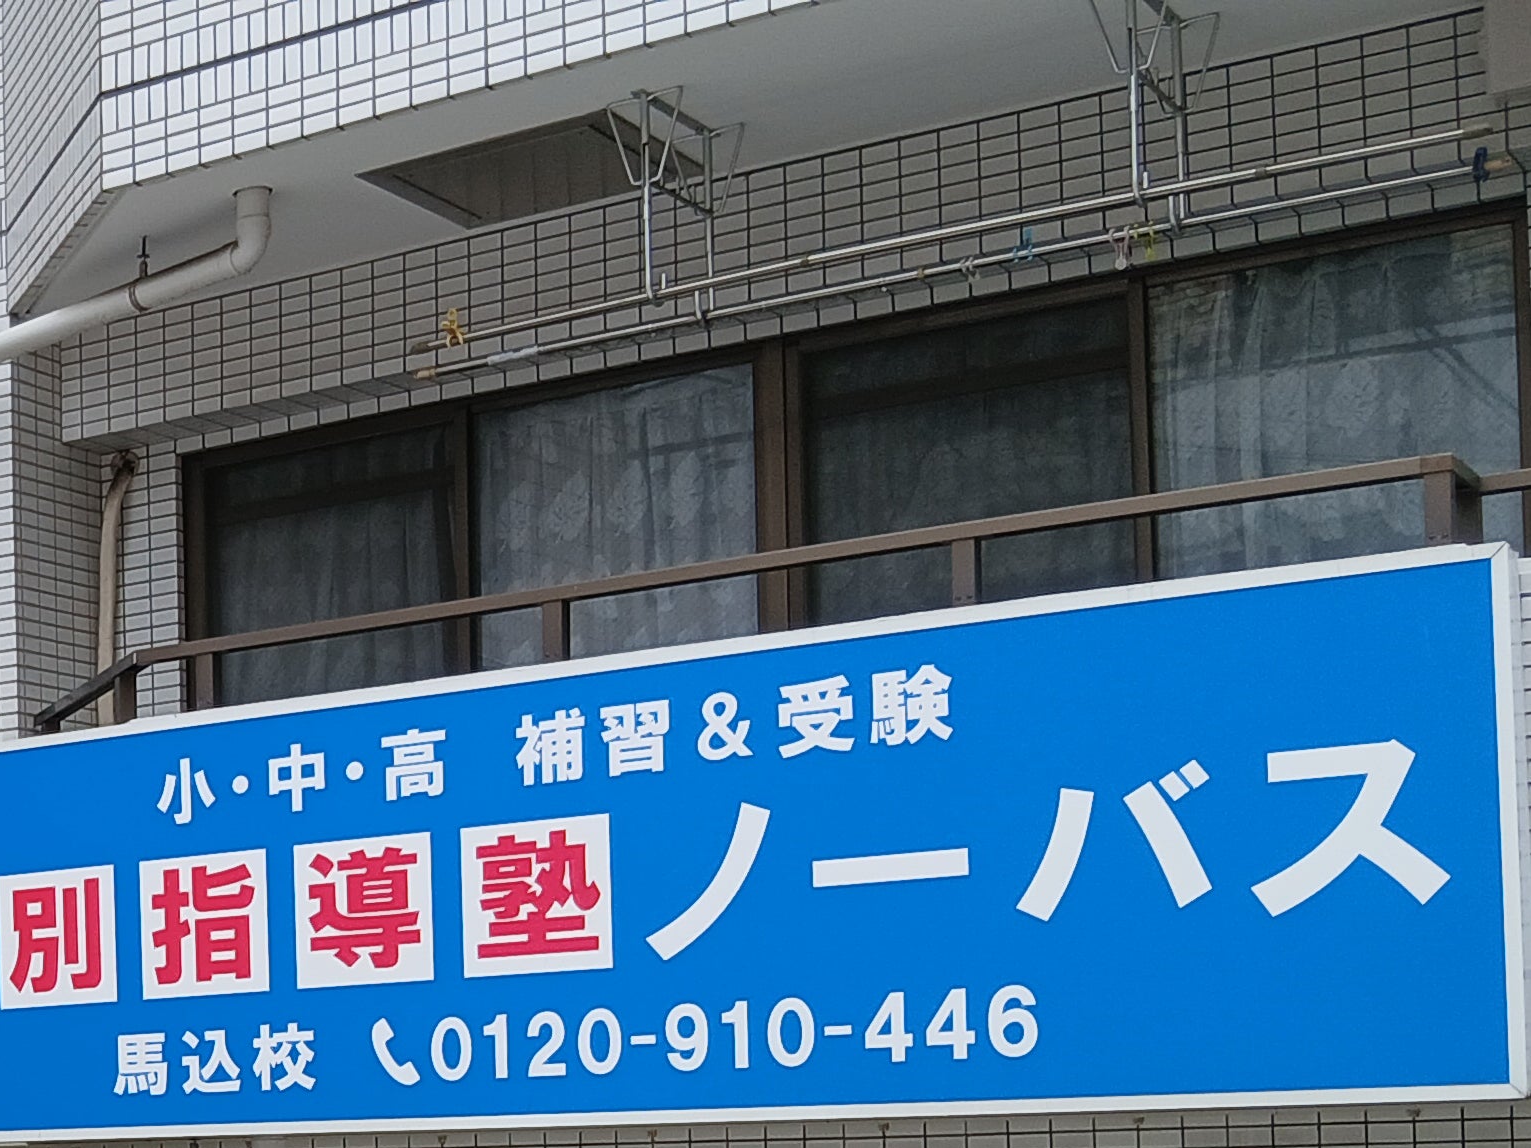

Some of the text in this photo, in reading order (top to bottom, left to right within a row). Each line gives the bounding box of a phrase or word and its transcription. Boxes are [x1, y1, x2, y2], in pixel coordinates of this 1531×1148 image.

[157, 664, 953, 824] 小・中・高 補習&受験
[645, 738, 1451, 961] ノーバス
[114, 984, 1040, 1096] 馬込校 0120-910-446
